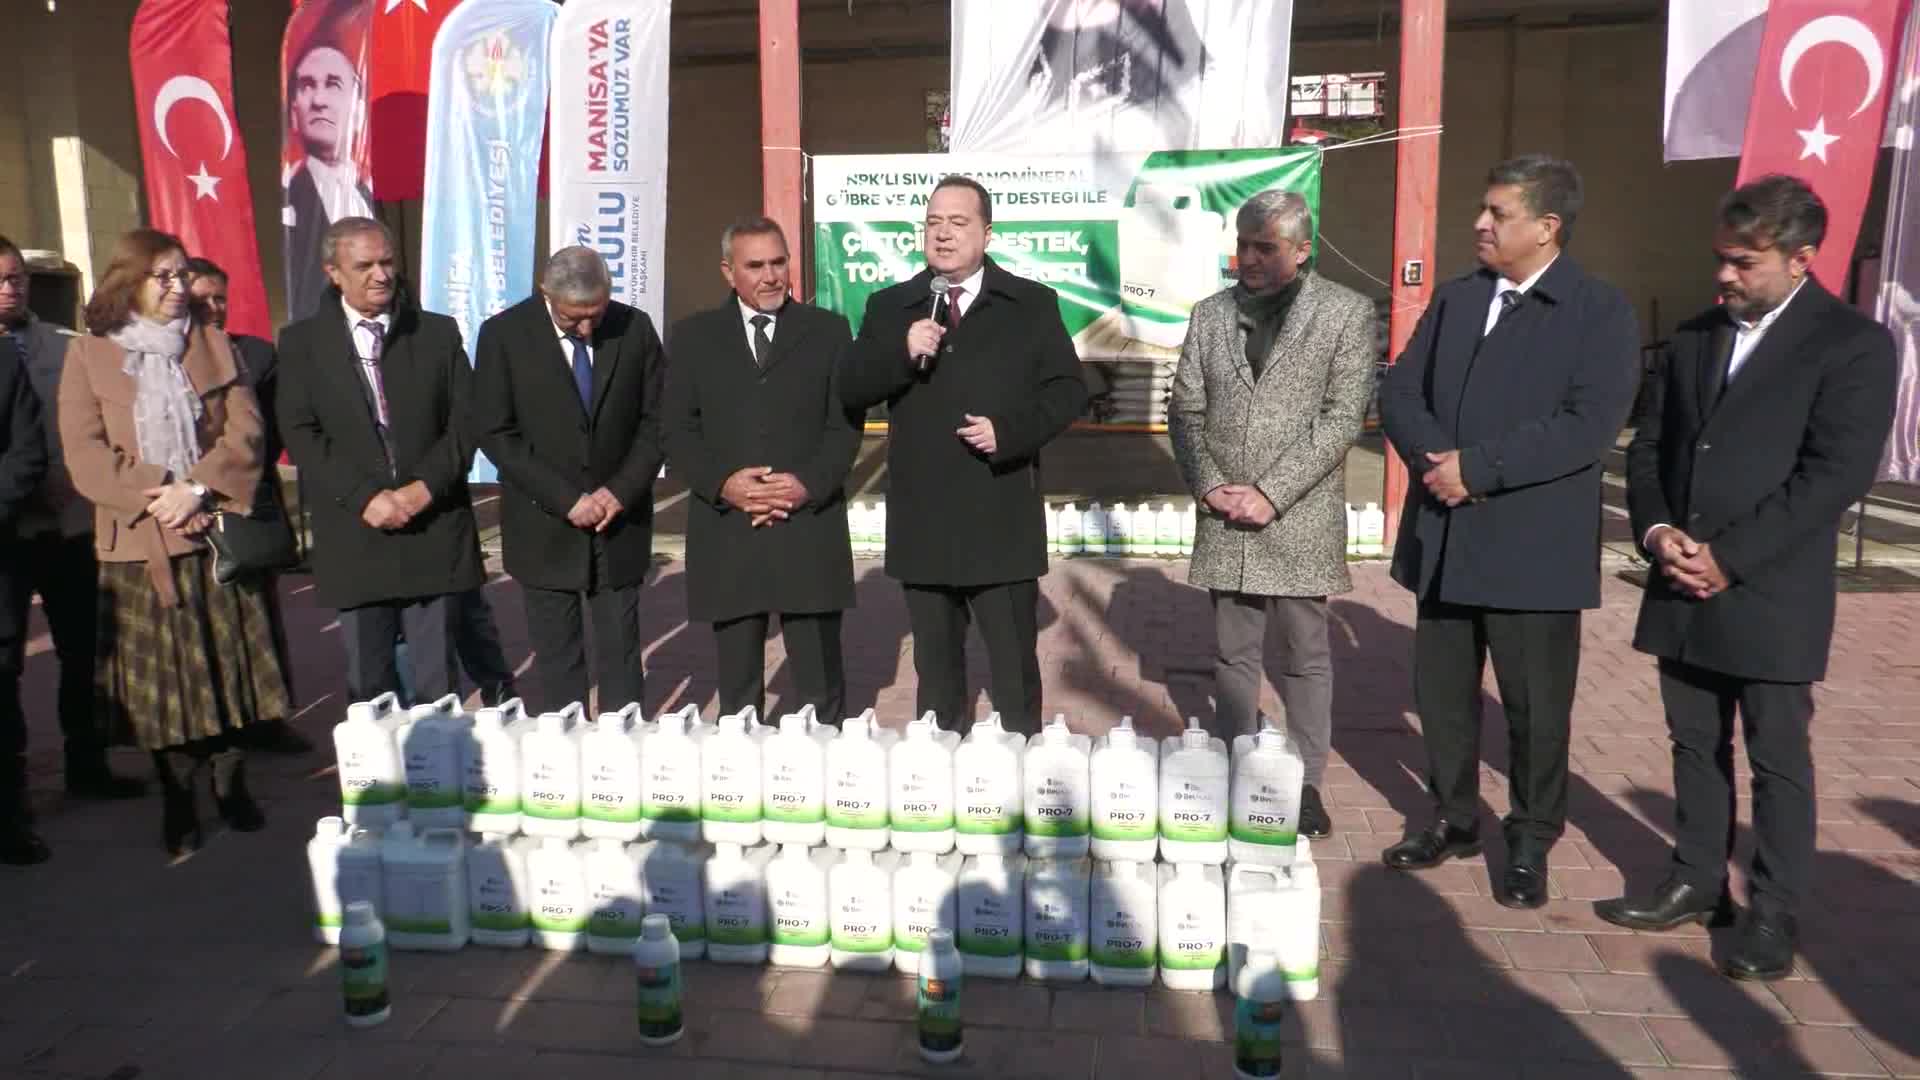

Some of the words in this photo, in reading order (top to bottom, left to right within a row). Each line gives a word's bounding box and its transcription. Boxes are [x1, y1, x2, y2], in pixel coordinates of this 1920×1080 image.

[614, 18, 630, 62] VAR
[585, 19, 608, 171] MANİSA'YA
[611, 67, 630, 171] SÖZÜMÜZ
[826, 189, 880, 206] GÜBRE
[1123, 285, 1156, 298] PRO-7
[533, 791, 565, 801] PRO-7
[592, 793, 624, 803] PRO-7
[652, 792, 685, 803] PRO-7
[711, 793, 744, 803] PRO-7
[772, 793, 806, 804] PRO-7
[836, 799, 871, 810] PRO-7
[903, 803, 937, 813] PRO-7
[967, 806, 1001, 815] PRO-7
[1038, 807, 1073, 817] PRO-7
[1110, 812, 1145, 821] PRO-7
[1174, 812, 1211, 822] PRO-7
[1248, 814, 1286, 825] PRO-7
[542, 905, 574, 914] PRO-7
[777, 918, 810, 928] PRO-7
[843, 924, 877, 934] PRO-7
[1106, 939, 1143, 950] PRO-7
[1178, 942, 1214, 951] PRO-7
